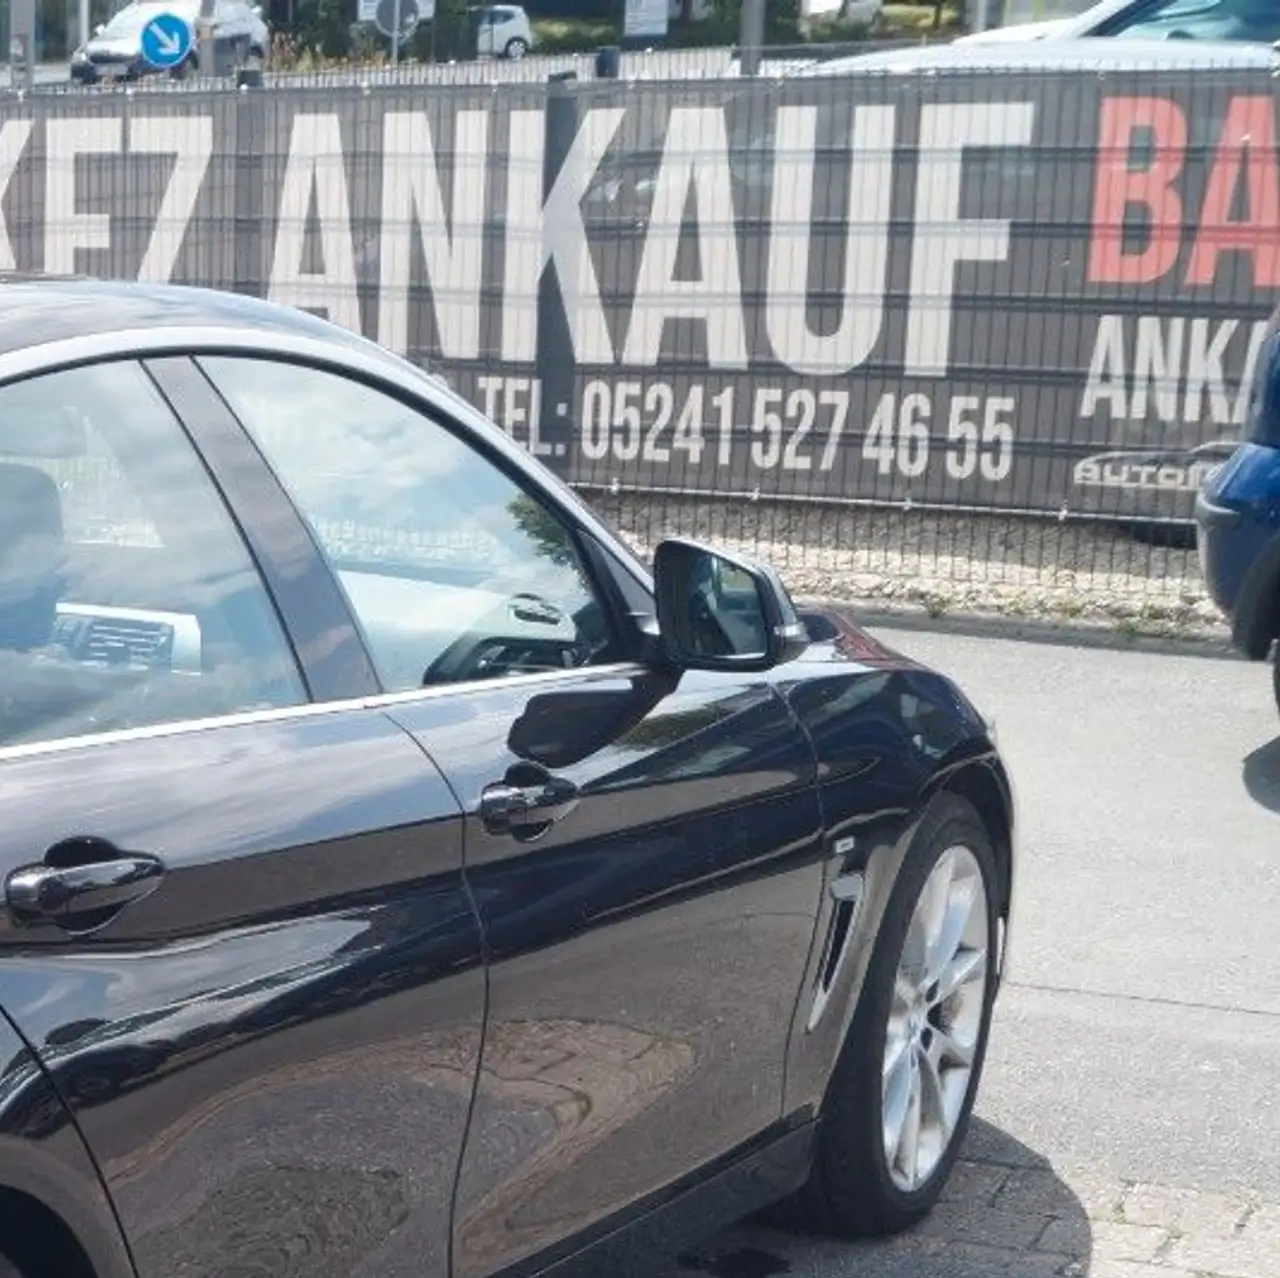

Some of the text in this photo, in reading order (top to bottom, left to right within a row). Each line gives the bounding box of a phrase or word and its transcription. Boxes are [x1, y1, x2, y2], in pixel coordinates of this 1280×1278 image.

[268, 101, 1035, 377] ANKAUF
[581, 380, 736, 466] 05241
[751, 389, 849, 472] 527
[862, 393, 930, 478] 46
[947, 396, 1015, 482] 55
